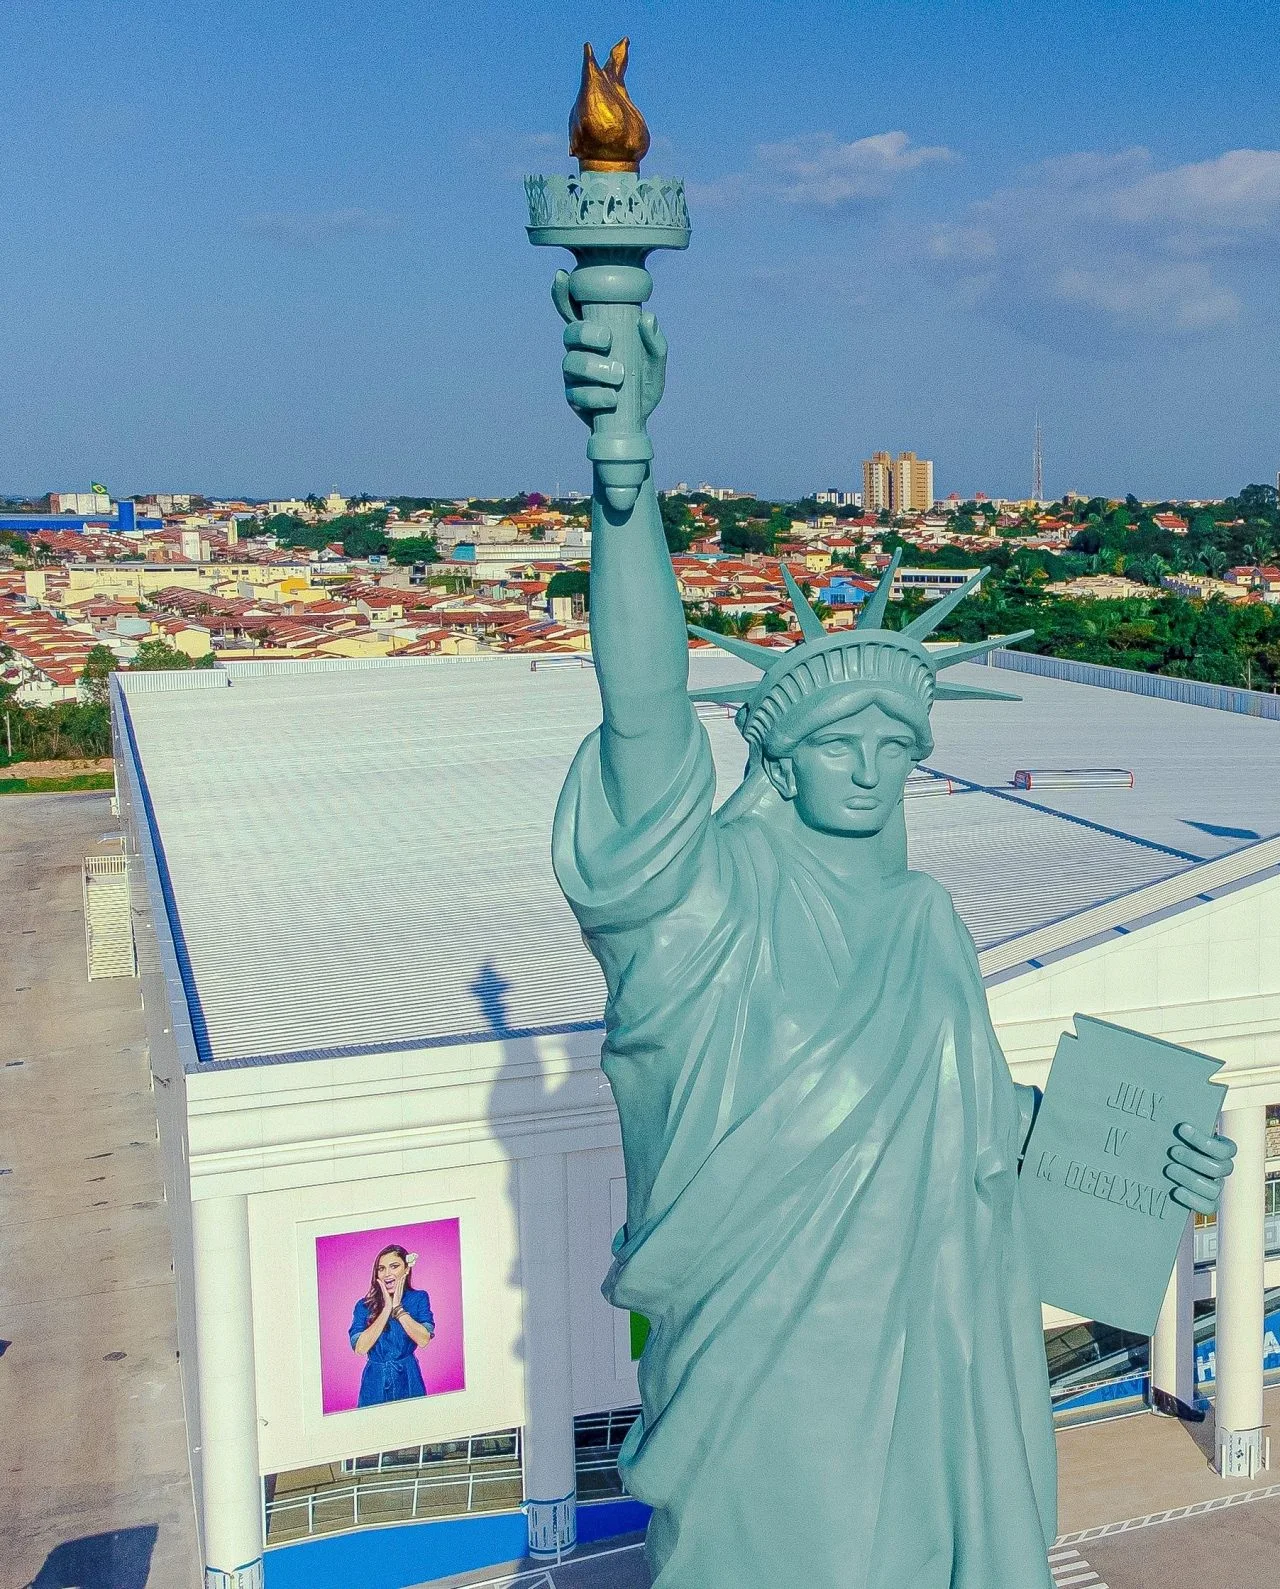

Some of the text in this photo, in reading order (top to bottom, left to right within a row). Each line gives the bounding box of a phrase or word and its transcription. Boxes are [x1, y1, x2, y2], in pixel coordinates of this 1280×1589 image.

[1107, 1081, 1165, 1122] JULY
[1103, 1126, 1131, 1157] IV
[1037, 1151, 1061, 1182] M
